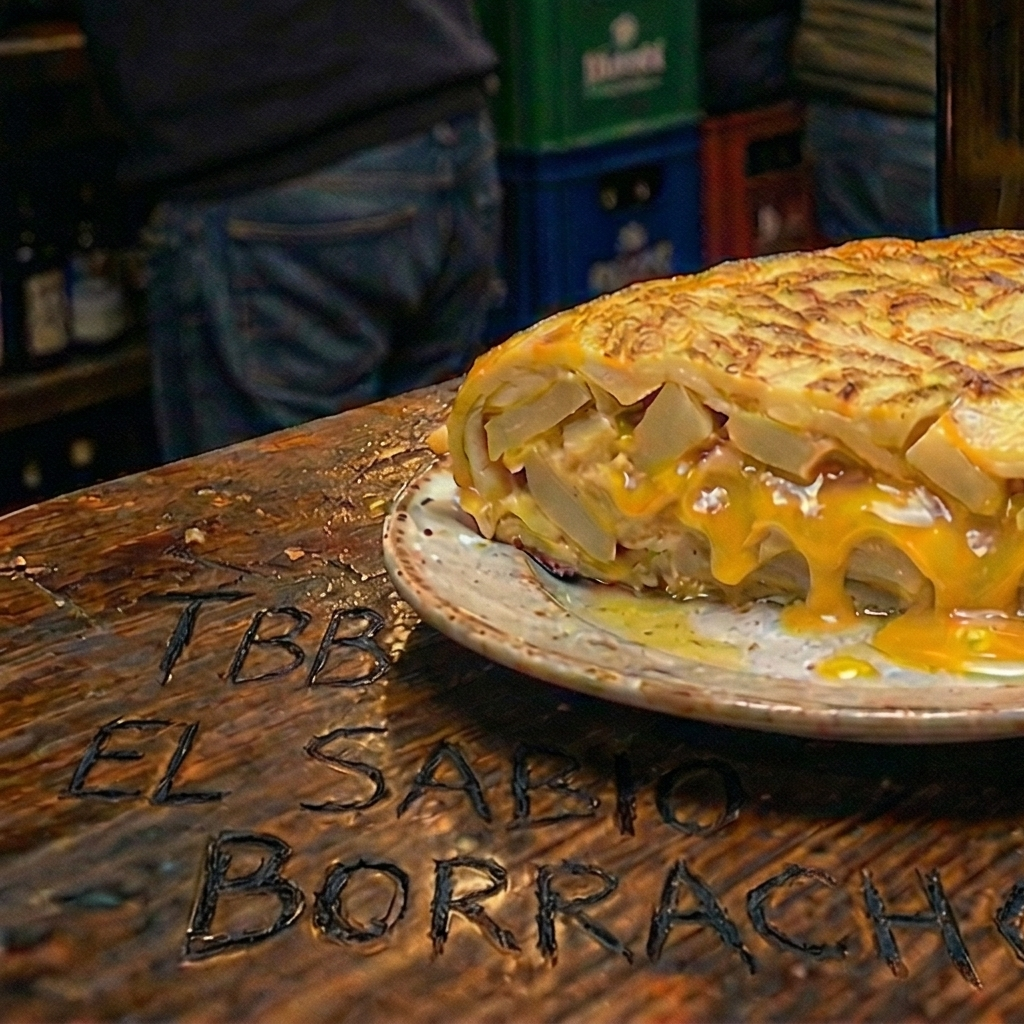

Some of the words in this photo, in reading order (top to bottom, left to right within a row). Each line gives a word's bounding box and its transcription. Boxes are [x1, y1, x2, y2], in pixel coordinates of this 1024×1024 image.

[140, 588, 391, 687] TBB
[58, 717, 230, 806] EL
[300, 726, 746, 837] SABIO
